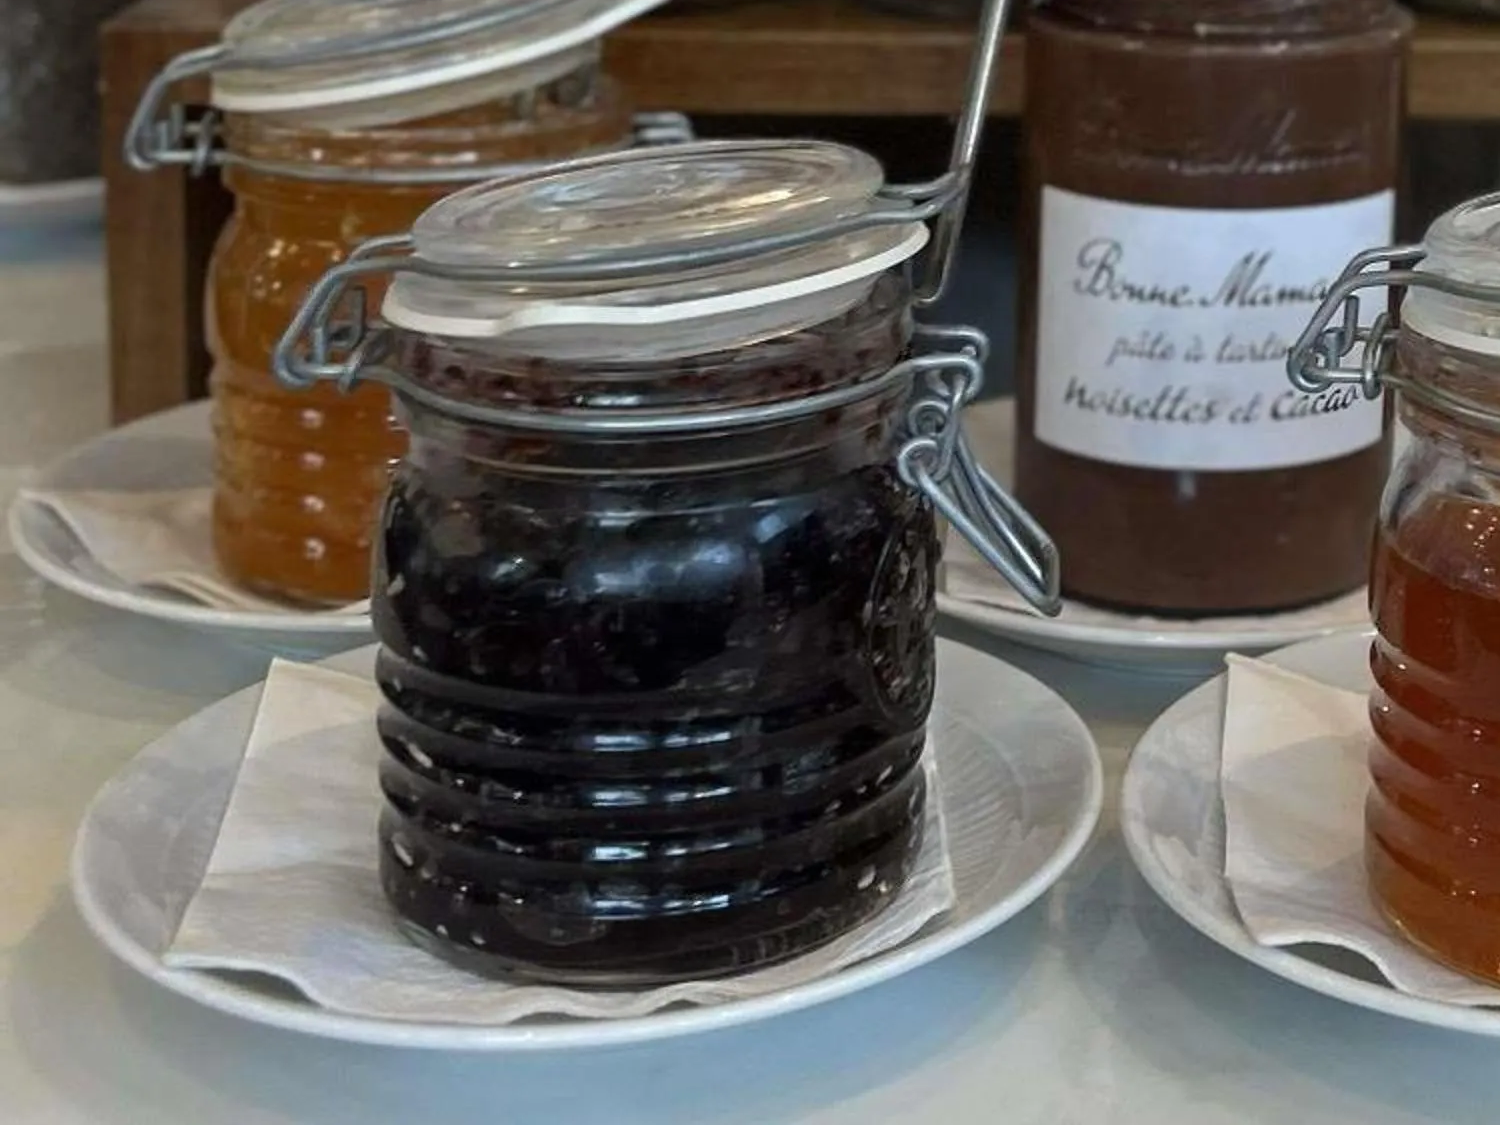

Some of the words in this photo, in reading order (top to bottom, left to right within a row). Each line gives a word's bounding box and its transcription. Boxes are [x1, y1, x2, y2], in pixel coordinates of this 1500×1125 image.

[1073, 237, 1195, 308] Bonne
[1199, 248, 1331, 307] Mama
[1215, 331, 1290, 364] tarti
[1228, 391, 1263, 424] et
